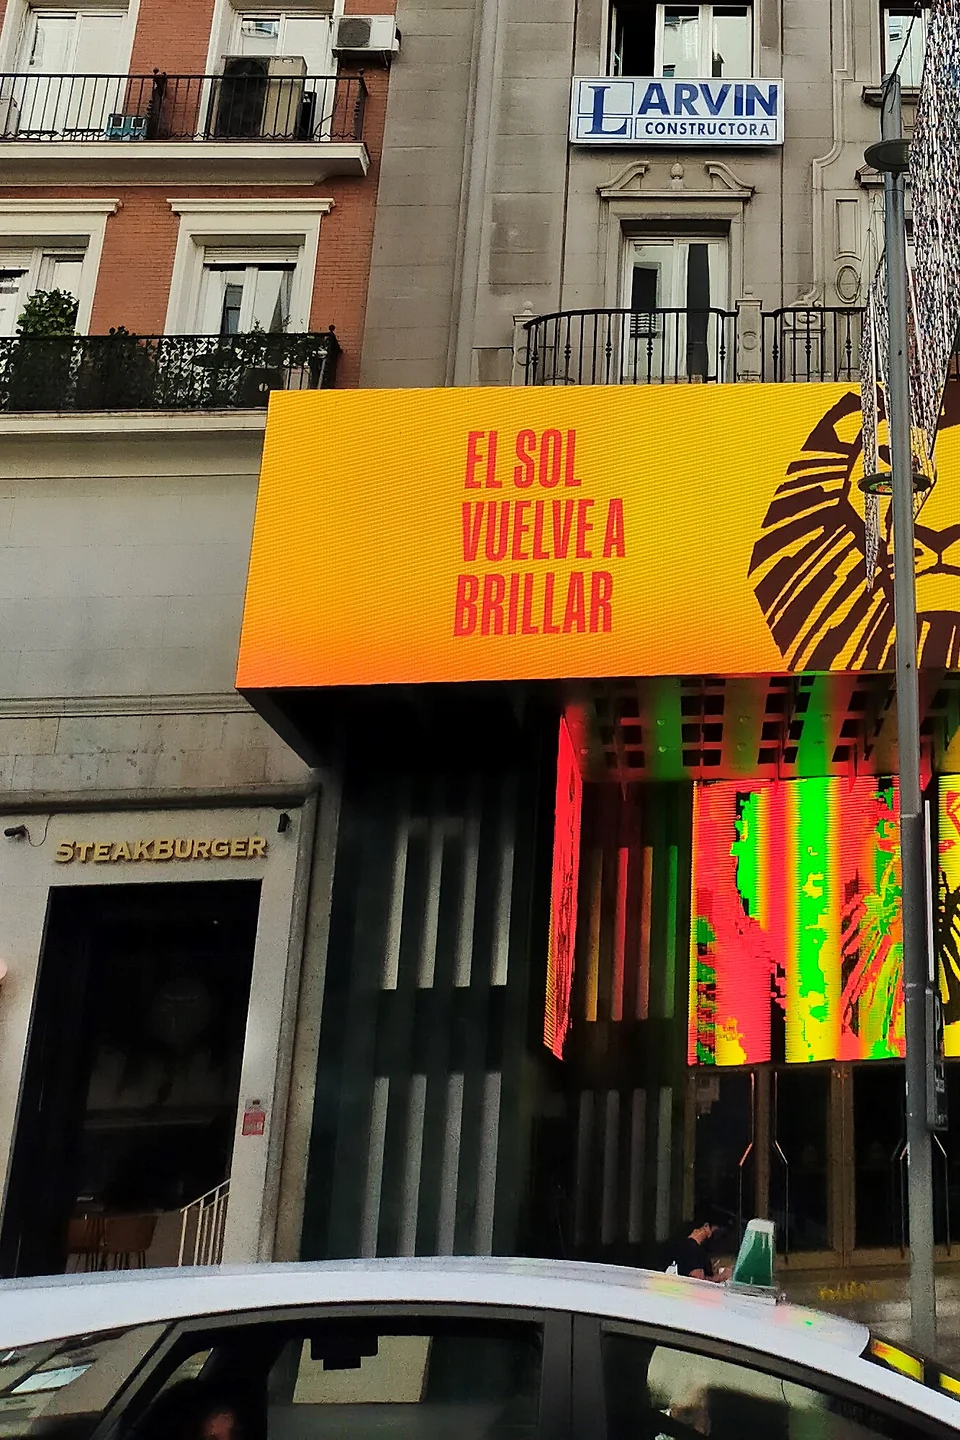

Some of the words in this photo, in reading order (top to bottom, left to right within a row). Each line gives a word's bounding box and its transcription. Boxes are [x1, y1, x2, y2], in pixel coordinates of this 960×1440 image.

[644, 121, 770, 136] CONSTRUCTORA
[464, 430, 503, 489] EL
[513, 428, 582, 489] SOL
[462, 499, 594, 562] VUELVE
[603, 498, 626, 558] A
[454, 571, 613, 637] BRILLAR
[54, 835, 268, 863] STEAKBURGER
